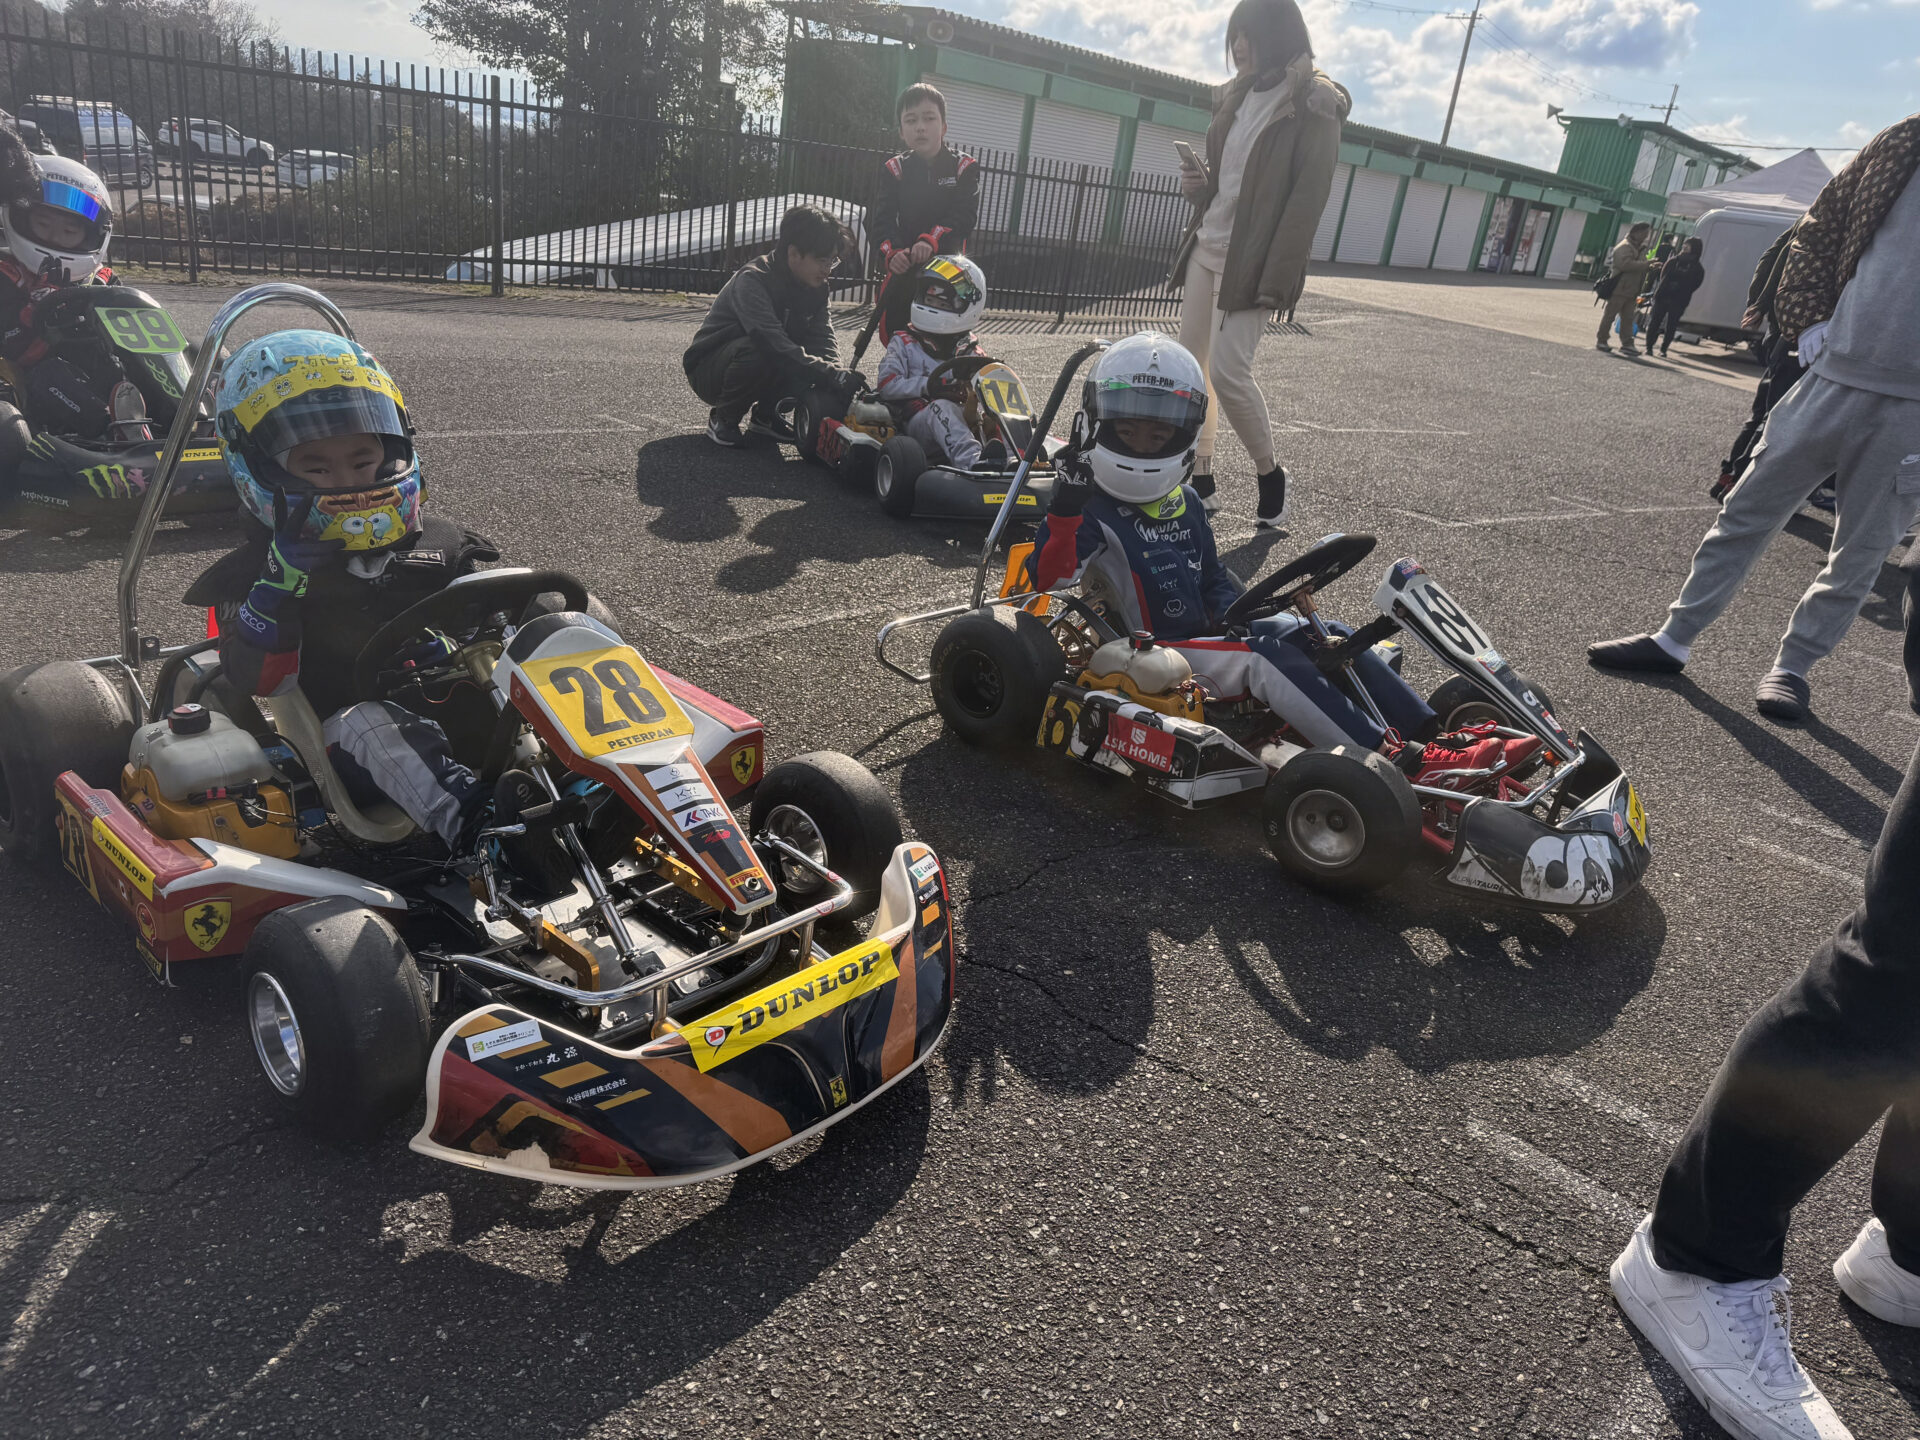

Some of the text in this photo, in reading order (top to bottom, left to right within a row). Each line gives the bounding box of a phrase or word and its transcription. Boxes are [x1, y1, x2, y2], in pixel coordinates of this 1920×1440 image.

[105, 309, 180, 349] 99
[985, 383, 1029, 415] 14
[1132, 375, 1175, 389] PETER-PAN
[1410, 584, 1488, 655] 69
[549, 659, 667, 737] 28
[606, 727, 675, 750] PETERPAN
[1104, 734, 1168, 768] LSK HOME
[104, 842, 148, 883] DUNLOP
[738, 951, 881, 1035] DUNLOP
